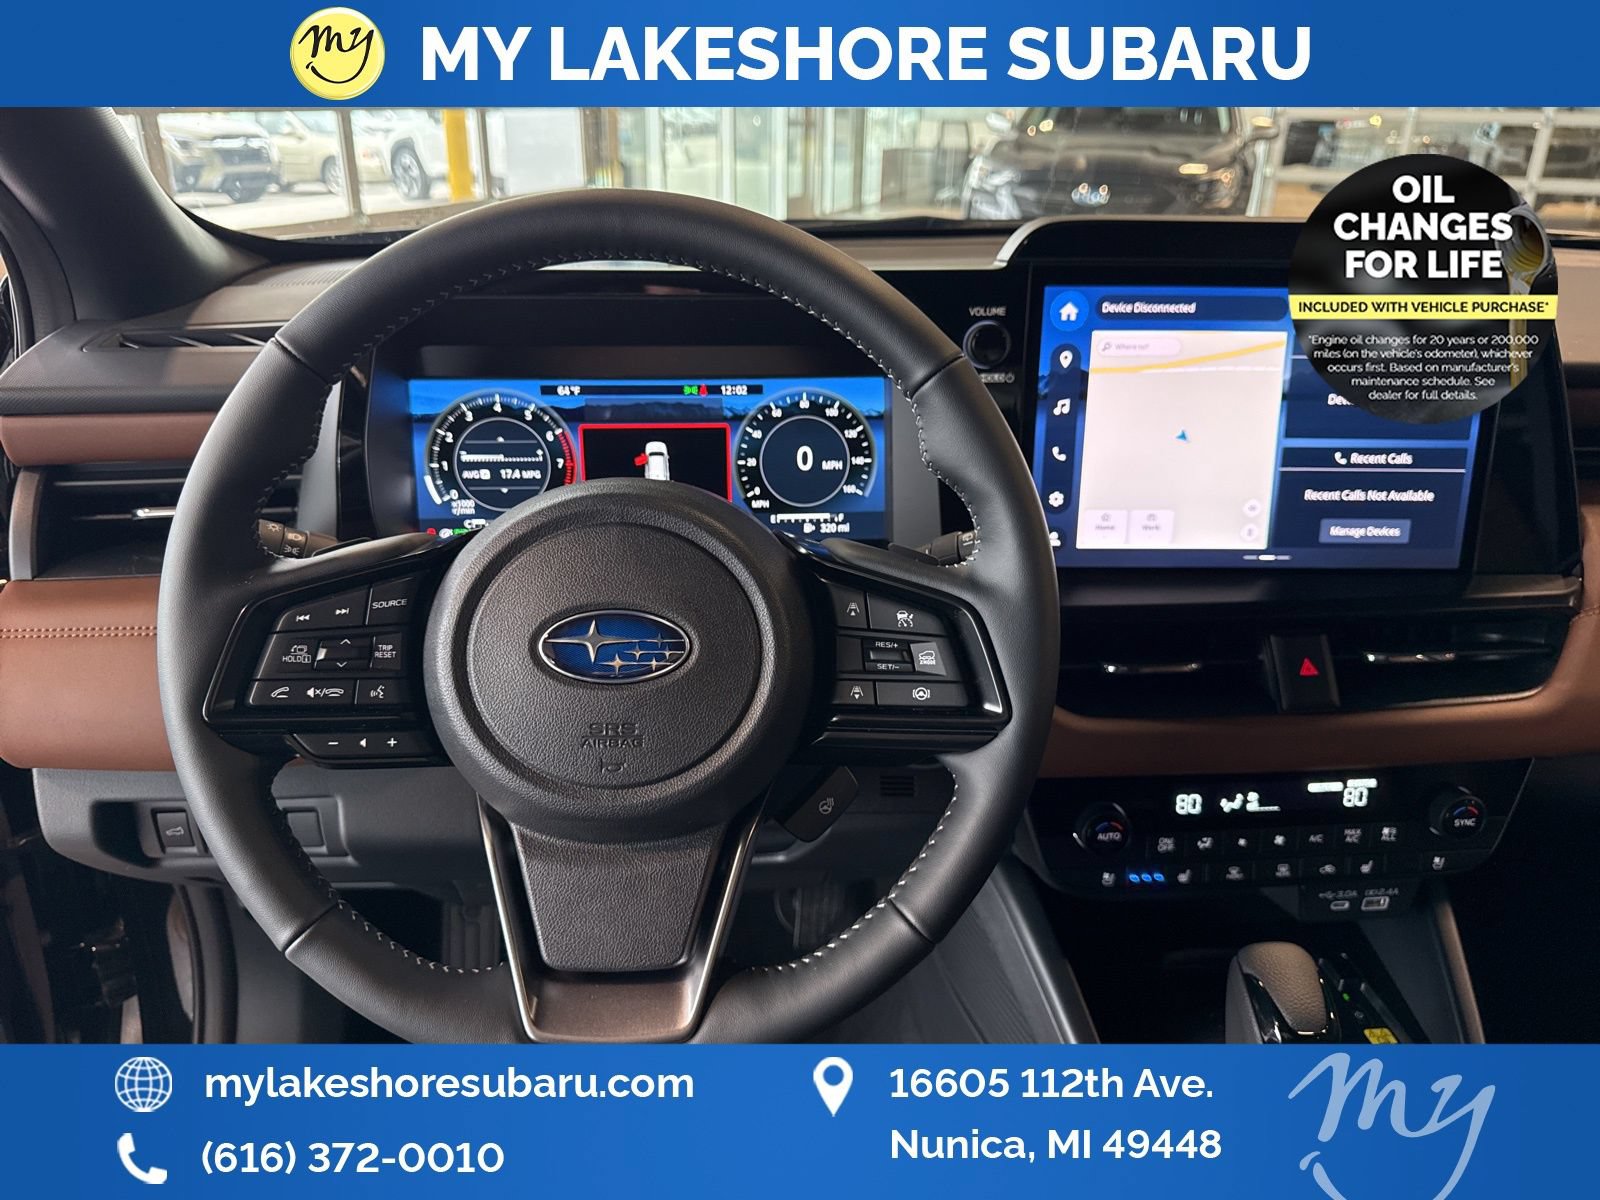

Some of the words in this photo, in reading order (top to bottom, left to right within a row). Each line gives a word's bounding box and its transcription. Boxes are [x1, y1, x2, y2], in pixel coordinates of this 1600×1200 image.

[968, 306, 1006, 317] VOLUME
[1102, 301, 1133, 314] Device
[1133, 301, 1196, 315] Disconnected
[721, 385, 748, 396] 12:02
[493, 402, 502, 413] 4
[799, 400, 810, 409] 80
[466, 412, 473, 422] 3
[524, 410, 533, 421] 5
[771, 408, 783, 418] 60
[825, 408, 839, 417] 100
[445, 432, 453, 443] 2
[546, 431, 554, 442] 6
[556, 458, 564, 468] 7
[796, 445, 814, 471] 0
[822, 460, 843, 471] MPH
[1351, 452, 1388, 465] Recent
[1388, 453, 1413, 465] Calls
[442, 461, 448, 471] 1
[462, 470, 480, 479] AVG
[522, 470, 542, 479] MPG
[450, 489, 459, 500] 0
[1304, 488, 1341, 501] Recent
[1341, 488, 1366, 501] Calls
[1367, 489, 1388, 501] Not
[1388, 488, 1435, 502] Available
[752, 501, 770, 509] MPH
[820, 522, 837, 533] 320
[838, 522, 850, 533] mi
[1329, 525, 1366, 538] Manage
[1366, 525, 1401, 537] Devices
[372, 599, 408, 609] SOURCE
[875, 641, 899, 649] RES/+
[282, 655, 302, 663] HOLD
[589, 723, 638, 736] SRS
[581, 736, 645, 749] AIRBAG
[1342, 786, 1369, 808] 80
[1175, 793, 1202, 815] 80
[1454, 818, 1477, 828] SYNC
[1097, 832, 1121, 841] AUTO
[1308, 834, 1324, 843] A/C
